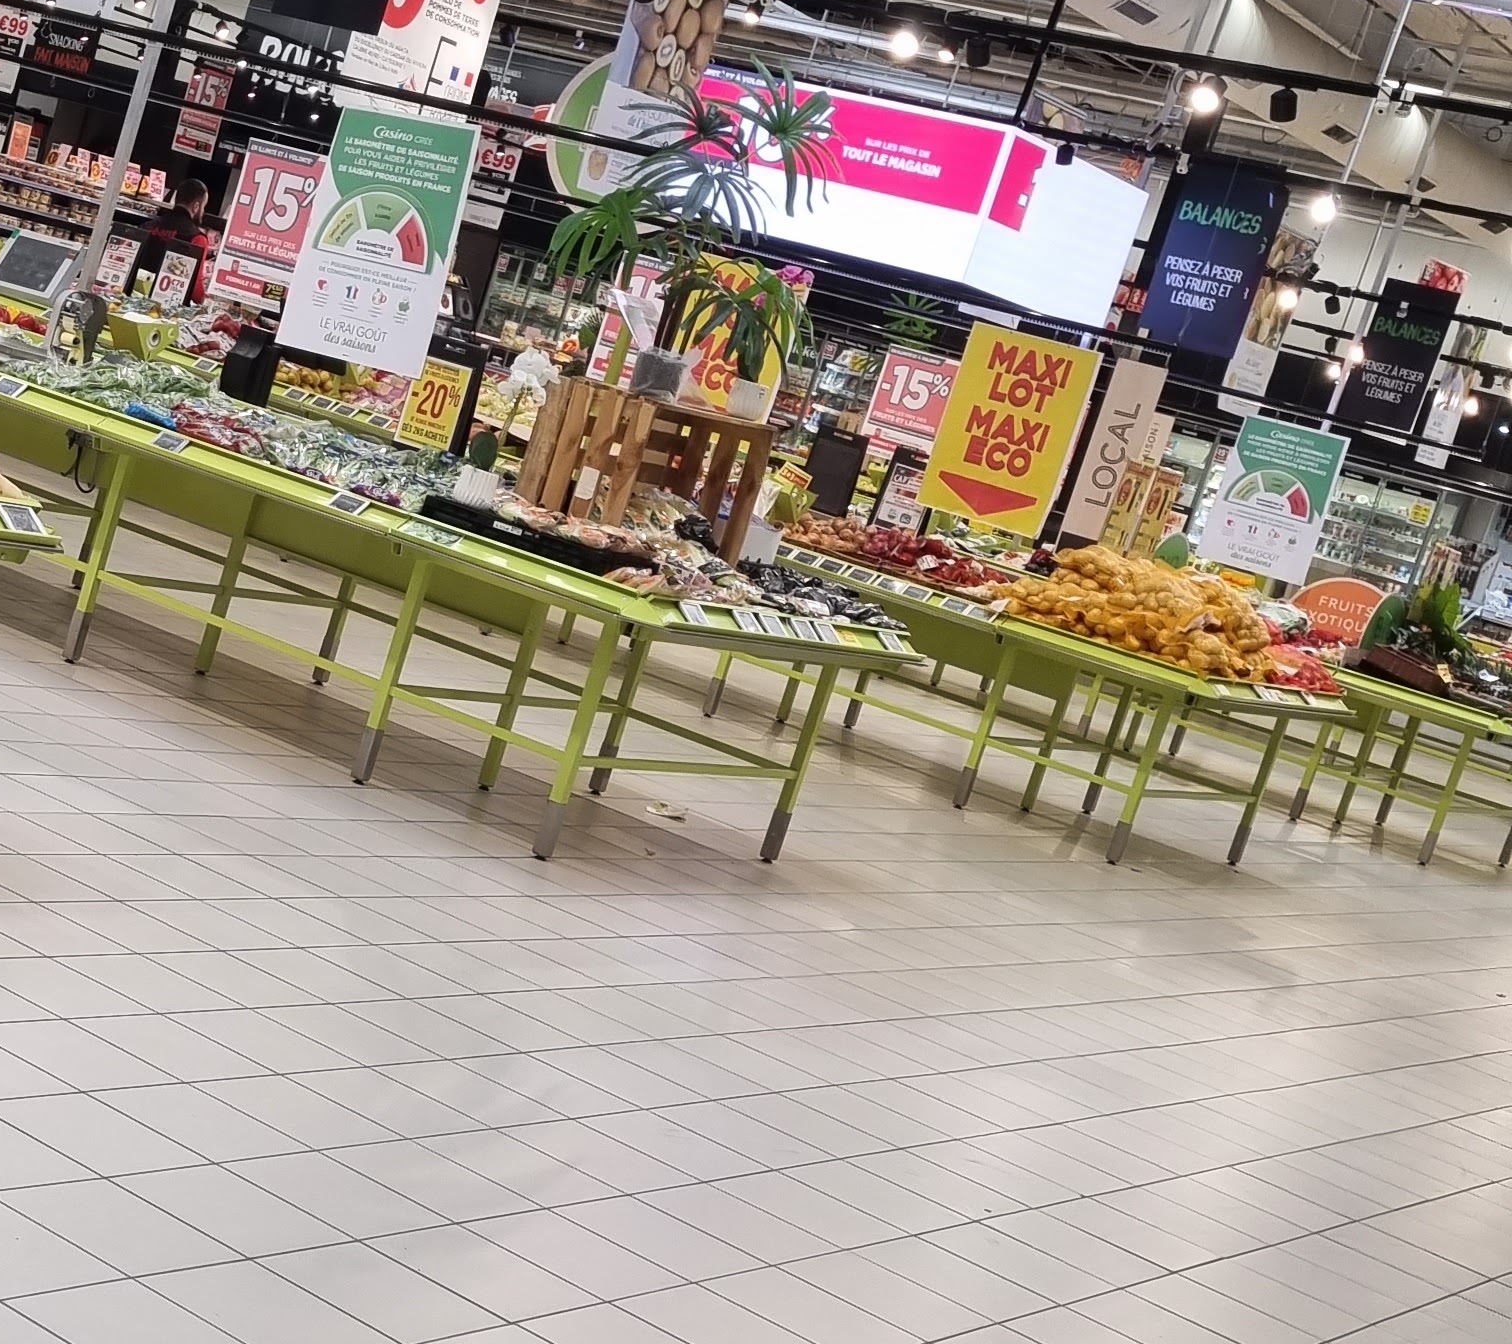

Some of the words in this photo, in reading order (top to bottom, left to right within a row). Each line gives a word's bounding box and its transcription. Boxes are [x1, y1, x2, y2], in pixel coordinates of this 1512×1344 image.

[0, 17, 29, 35] €99
[434, 13, 480, 37] CONSOMMATION
[49, 33, 84, 51] SNACKING
[34, 47, 54, 63] FAIT
[55, 52, 91, 74] MAISON
[374, 126, 413, 142] Casino
[866, 138, 882, 149] SUR
[883, 142, 897, 151] LES
[899, 144, 916, 154] PRIX
[918, 149, 930, 158] DE
[843, 146, 872, 163] TOUT
[873, 153, 887, 167] LE
[888, 156, 941, 178] MAGASIN
[1179, 200, 1263, 235] BALANCES
[1164, 255, 1203, 274] PENSEZ
[1202, 261, 1210, 277] À
[1211, 264, 1243, 284] PESER
[1166, 272, 1186, 288] VOS
[1185, 276, 1219, 296] FRUITS
[1218, 284, 1234, 298] ET
[1170, 289, 1216, 311] LÉGUMES
[320, 317, 332, 329] LE
[333, 320, 356, 336] VRAI
[356, 327, 388, 343] GOÛT
[324, 331, 339, 345] des
[341, 337, 377, 354] saisons
[1374, 317, 1440, 346] BALANCES
[988, 341, 1073, 389] MAXI
[1362, 360, 1392, 376] PENSEZ
[1398, 368, 1424, 383] PESER
[881, 365, 951, 411] -15%
[989, 372, 1056, 413] LOT
[1362, 372, 1377, 385] VOS
[1377, 375, 1405, 392] FRUITS
[1404, 383, 1416, 393] ET
[1365, 386, 1403, 404] LÉGUMES
[411, 380, 461, 419] -20%
[965, 405, 1050, 453] MAXI
[963, 435, 1032, 477] ECO
[1085, 403, 1141, 508] LOCAL
[1318, 595, 1375, 618] FRUITS
[1300, 608, 1366, 632] XOTIQU
